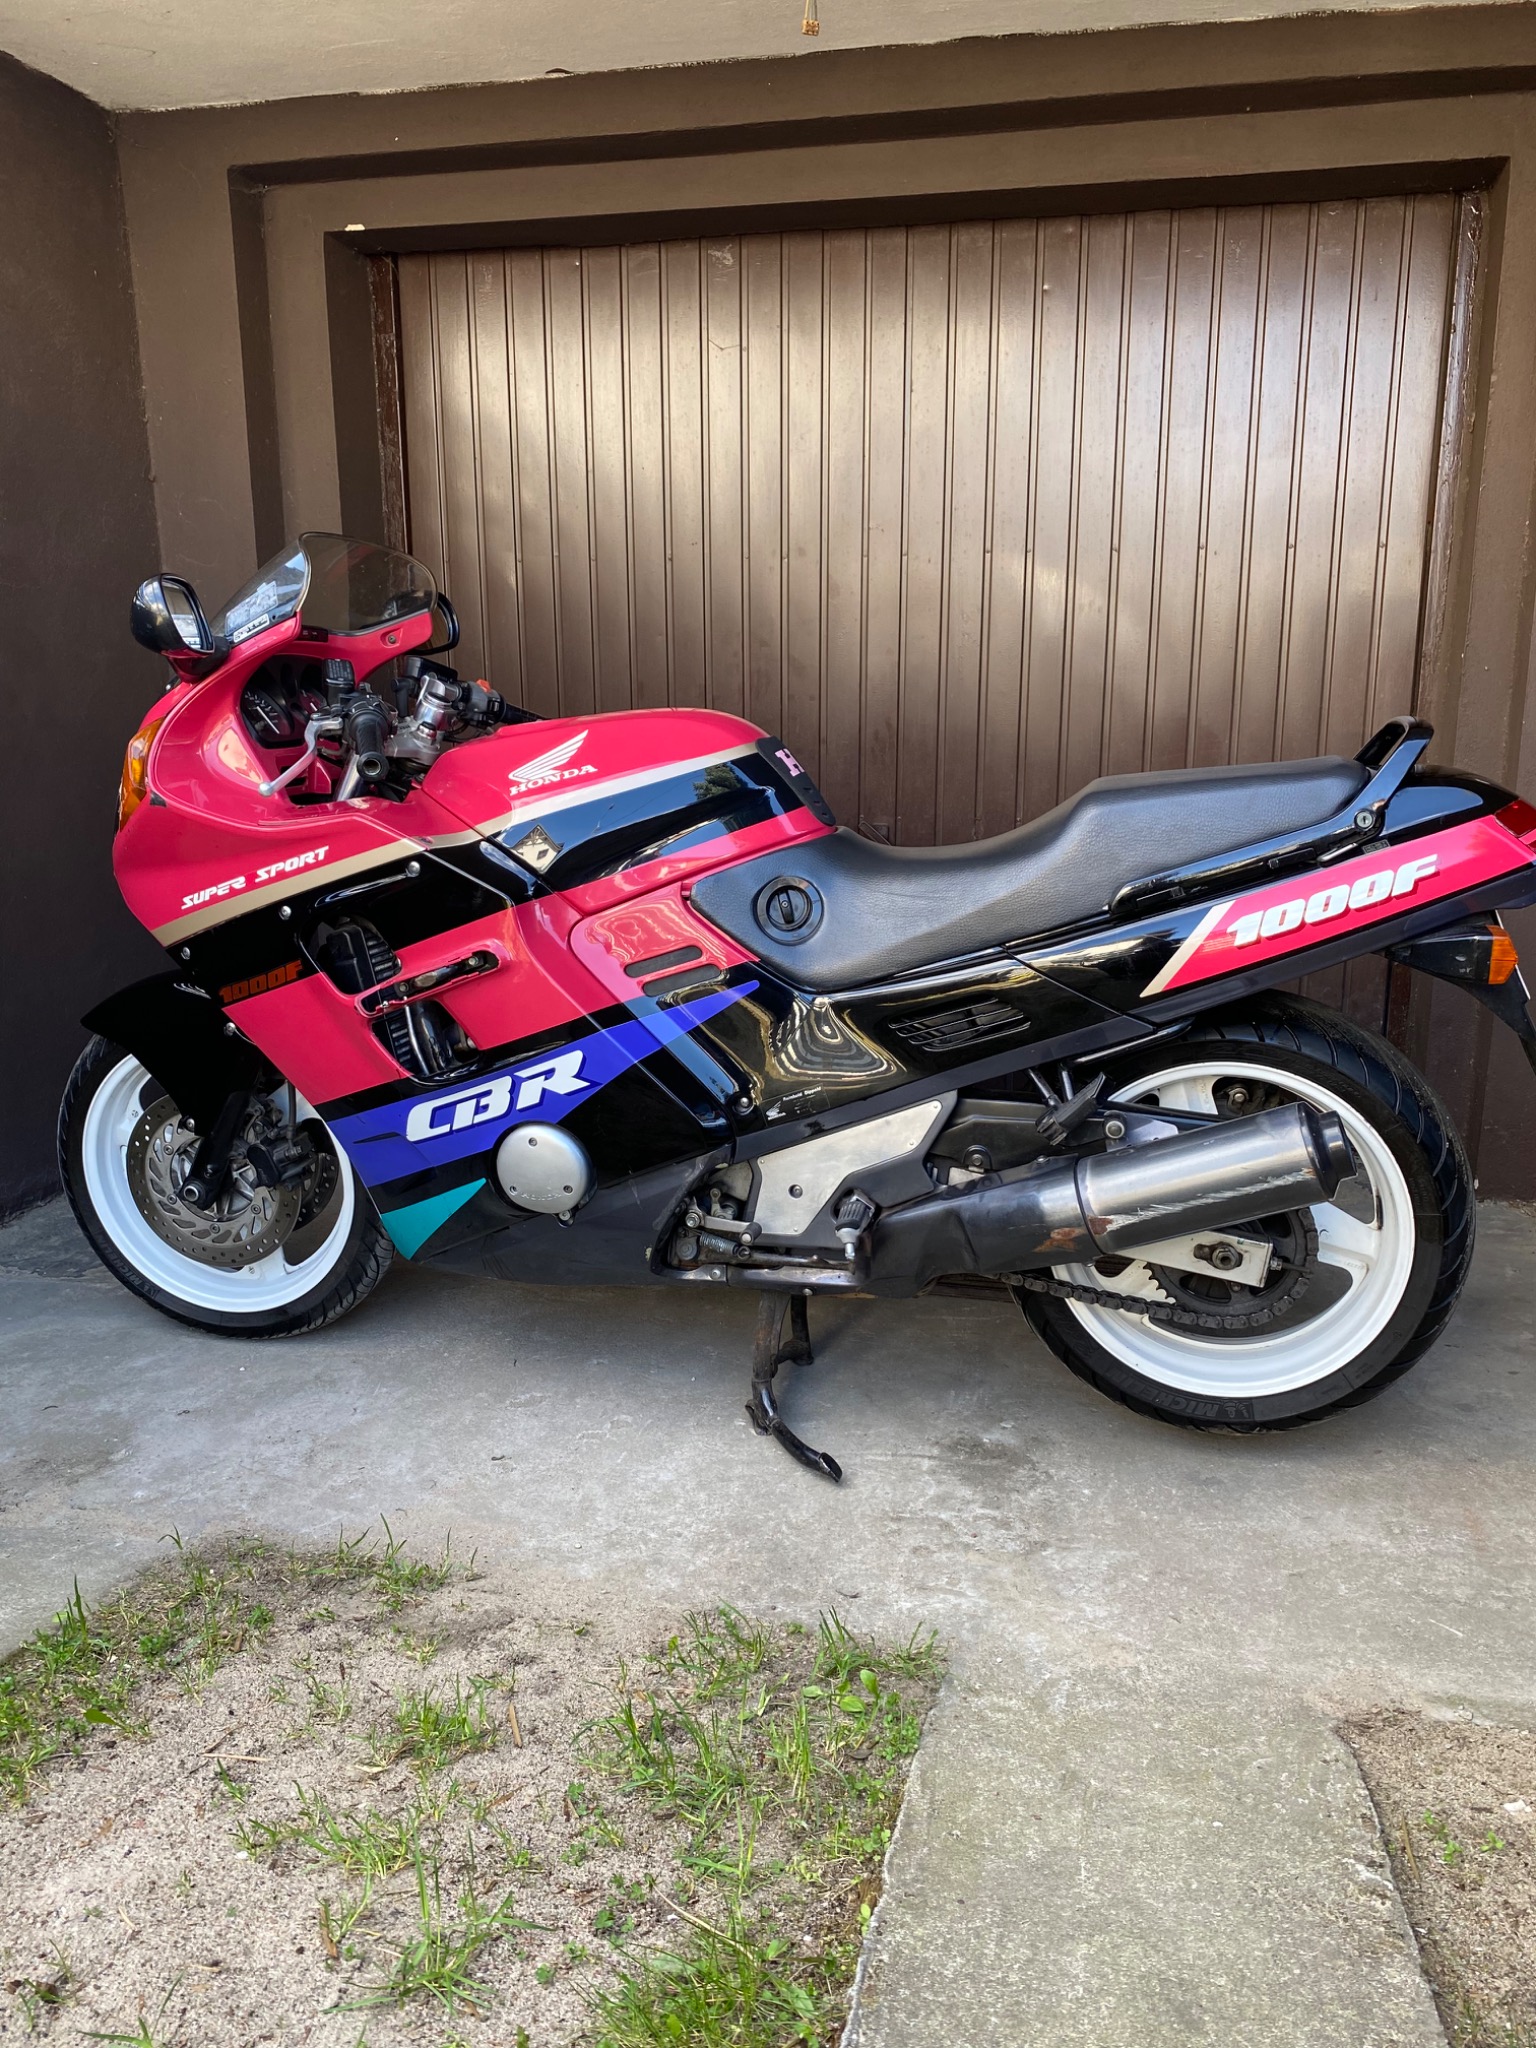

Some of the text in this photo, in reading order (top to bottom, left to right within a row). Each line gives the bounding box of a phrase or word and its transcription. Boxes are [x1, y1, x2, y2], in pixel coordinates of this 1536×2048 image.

[509, 764, 598, 796] HONDA
[181, 846, 329, 910] SUPER SPORT
[1226, 854, 1439, 949] 1000F
[219, 960, 303, 1004] 1000F
[406, 1050, 592, 1143] CBR
[93, 1232, 143, 1287] MICHELIN
[1104, 1364, 1220, 1418] MICHELIN
